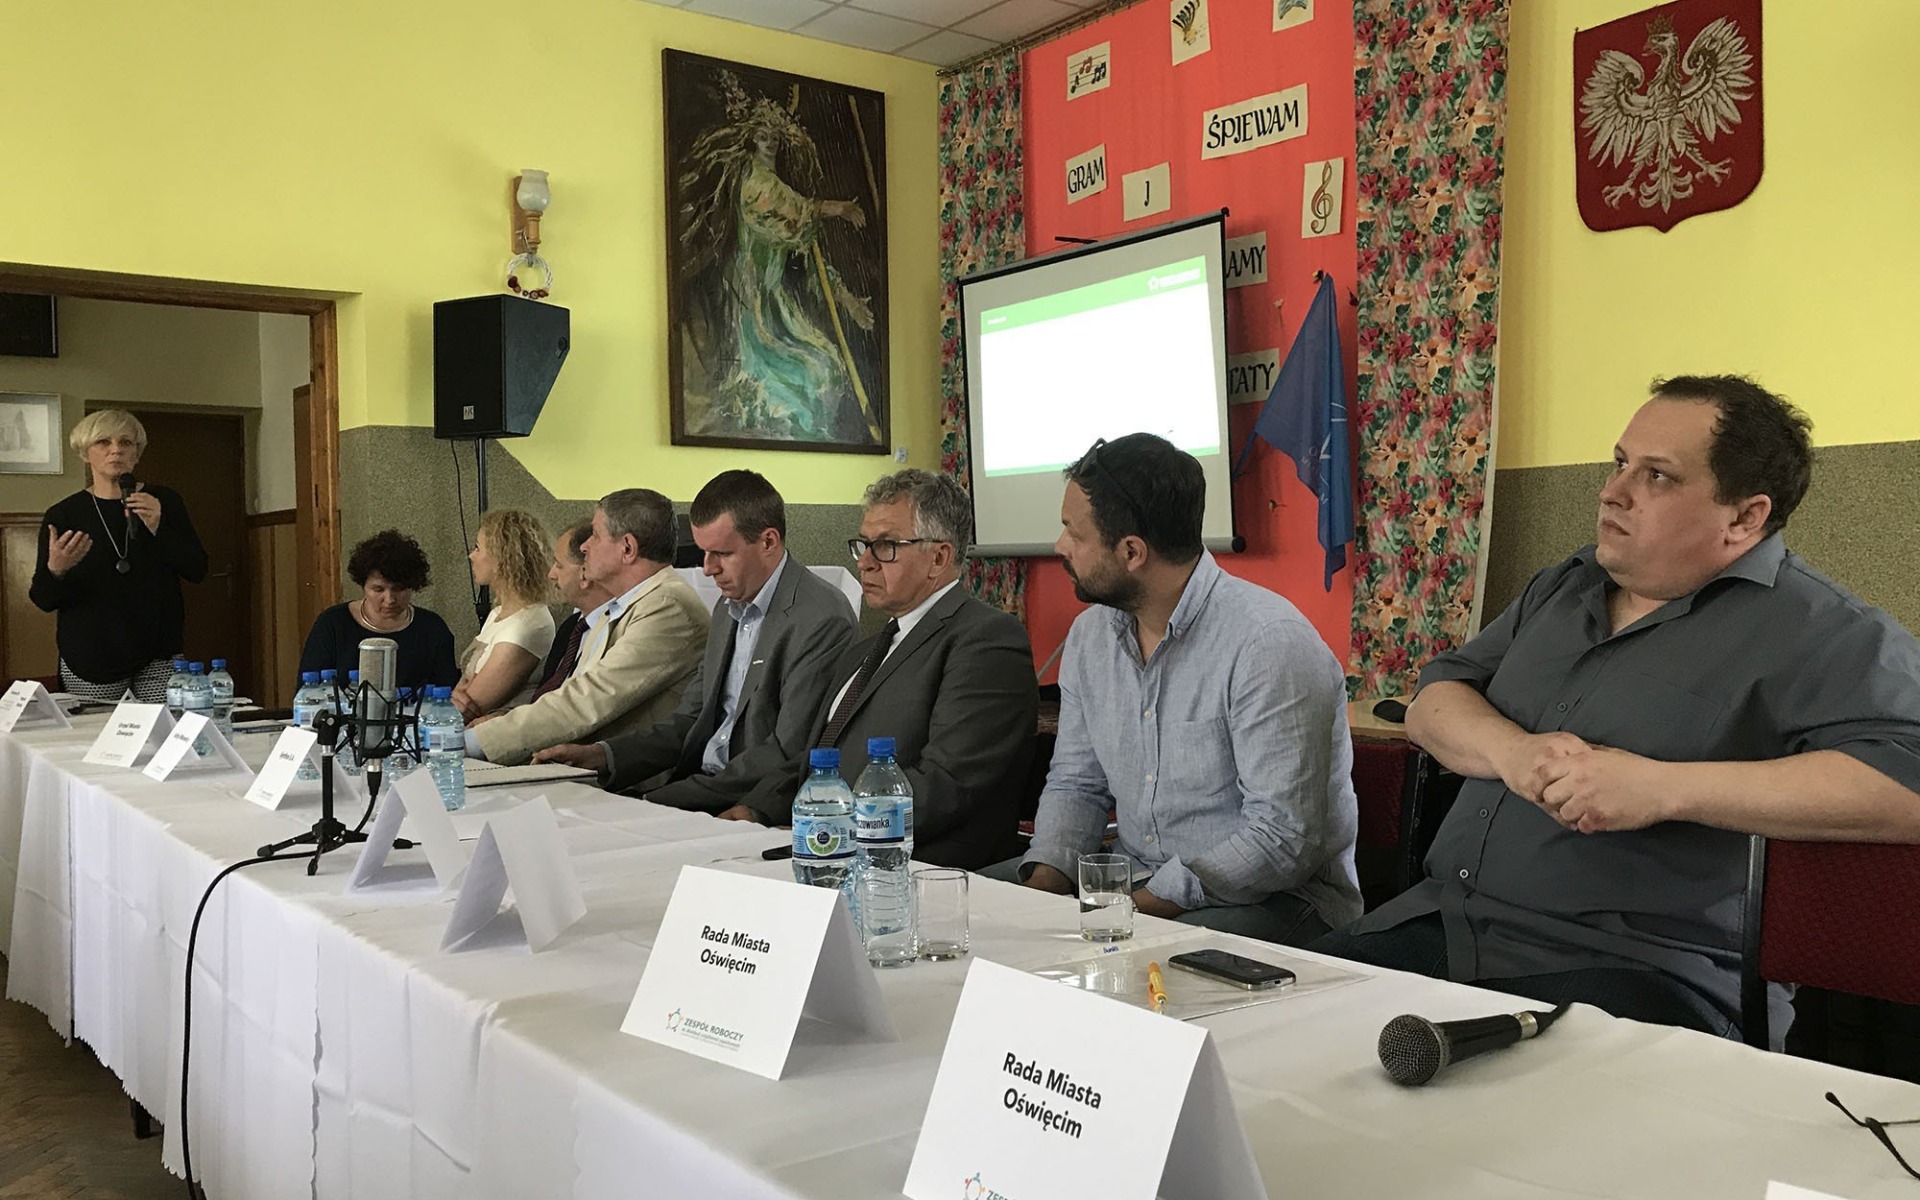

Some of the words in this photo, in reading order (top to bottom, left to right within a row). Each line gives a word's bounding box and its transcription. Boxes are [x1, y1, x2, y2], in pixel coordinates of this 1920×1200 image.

[1067, 156, 1105, 194] GRAM
[1226, 245, 1266, 278] AMY
[1228, 362, 1275, 395] TATY
[700, 925, 730, 944] Rada
[731, 931, 771, 954] Miasta
[700, 948, 757, 975] Oświęcim
[710, 1025, 744, 1042] ROBOCZY
[1002, 1051, 1043, 1085] Rada
[1045, 1068, 1102, 1110] Miasta
[1003, 1087, 1083, 1139] Oświęcim
